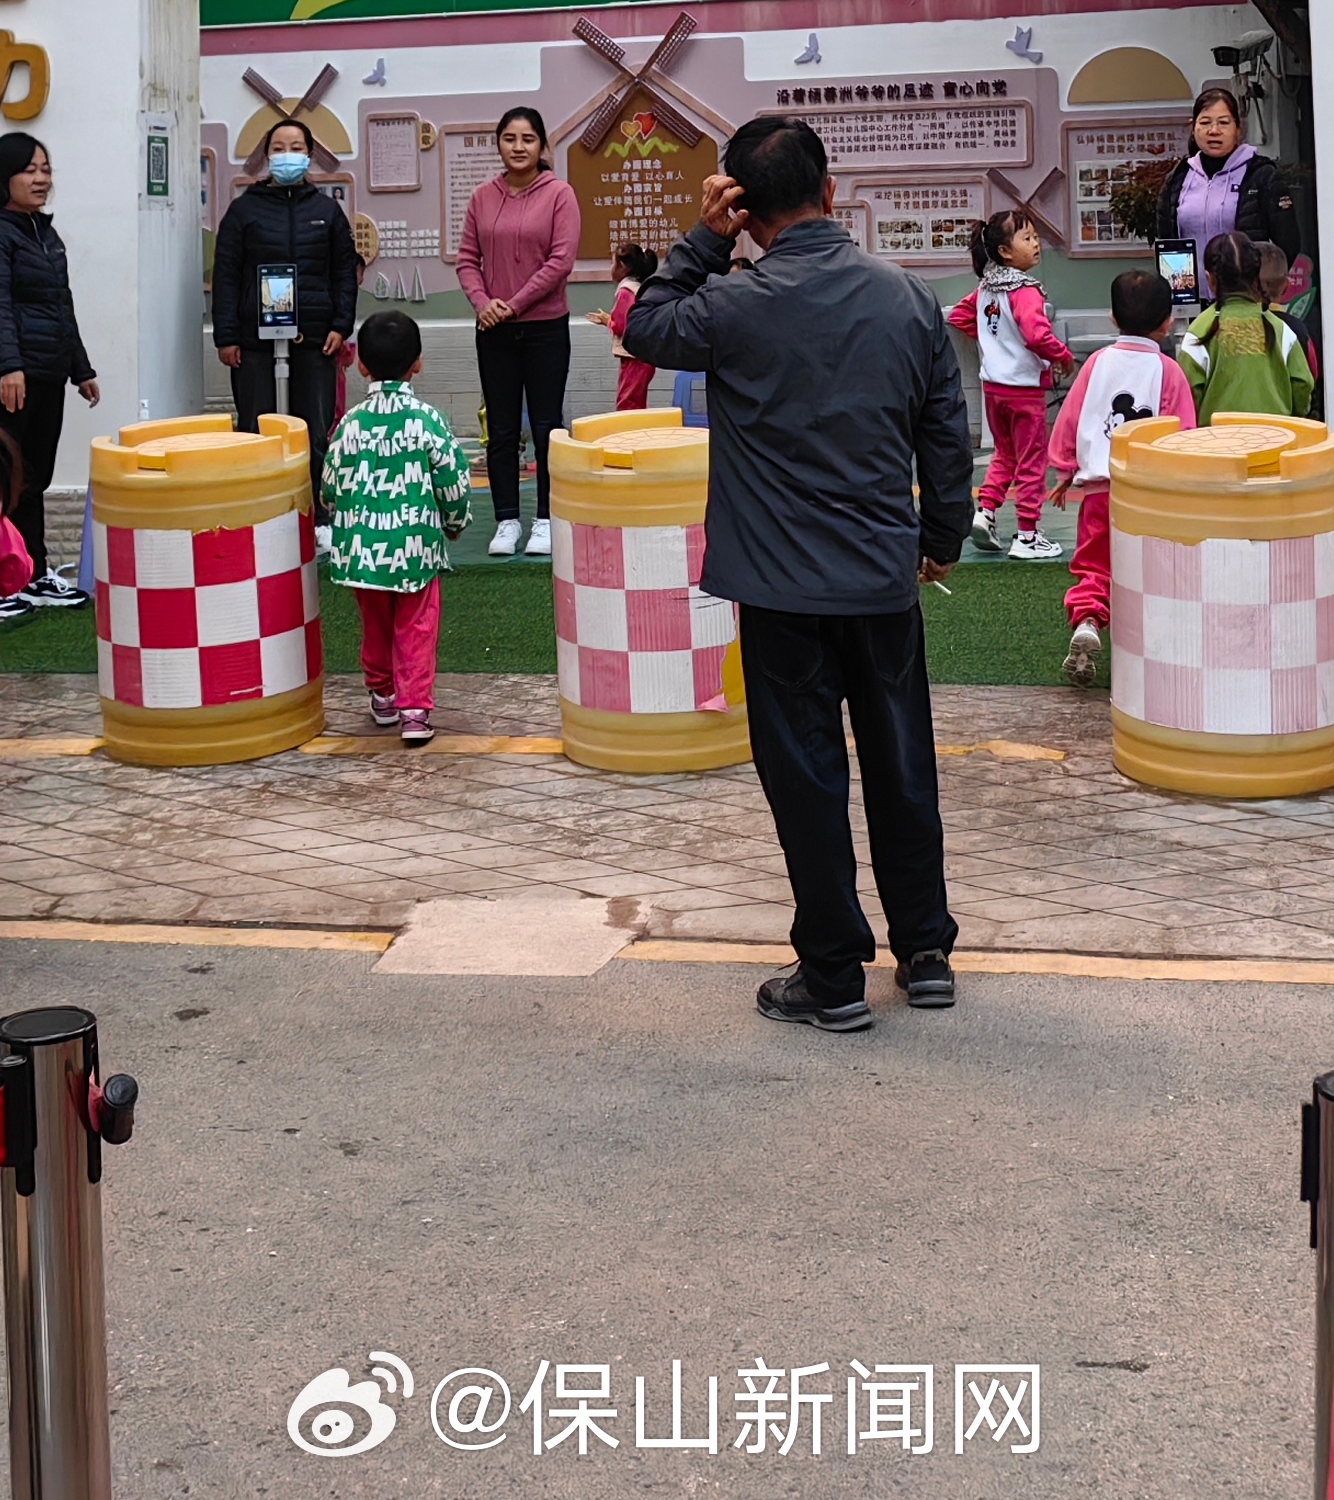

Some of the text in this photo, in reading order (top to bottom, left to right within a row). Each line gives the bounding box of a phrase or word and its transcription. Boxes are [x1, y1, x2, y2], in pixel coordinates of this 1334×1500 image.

[942, 79, 1007, 97] 童心向党
[593, 194, 693, 206] 让爱伴随我们一起成长
